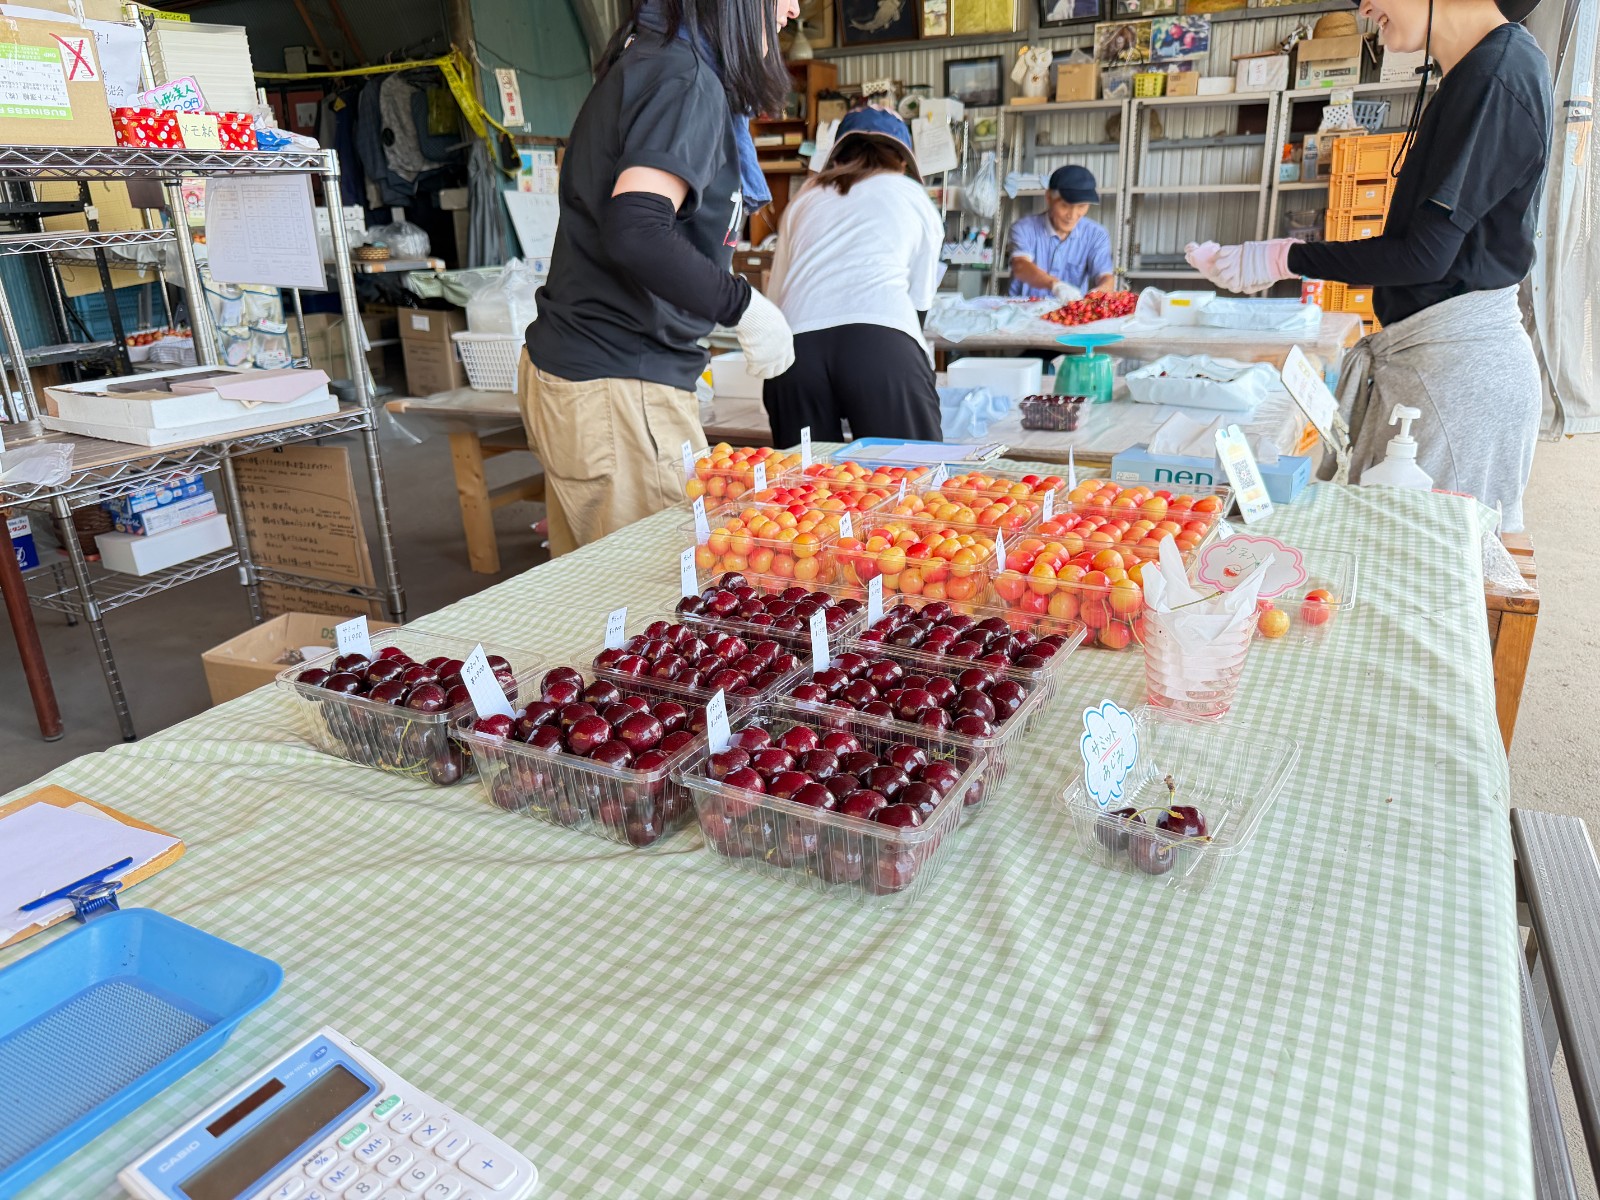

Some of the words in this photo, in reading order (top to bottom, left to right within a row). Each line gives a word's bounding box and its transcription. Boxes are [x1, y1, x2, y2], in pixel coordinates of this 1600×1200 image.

[7, 107, 67, 117] BUSINESS
[181, 123, 216, 137] メモ紙
[1091, 722, 1118, 759] サミット
[1102, 746, 1125, 782] あじみ
[361, 1138, 383, 1155] M+
[158, 1140, 201, 1173] CASIO
[314, 1155, 329, 1166] %
[387, 1153, 402, 1167] 9
[411, 1168, 426, 1180] 6
[355, 1181, 371, 1194] 8
[434, 1183, 450, 1195] 3
